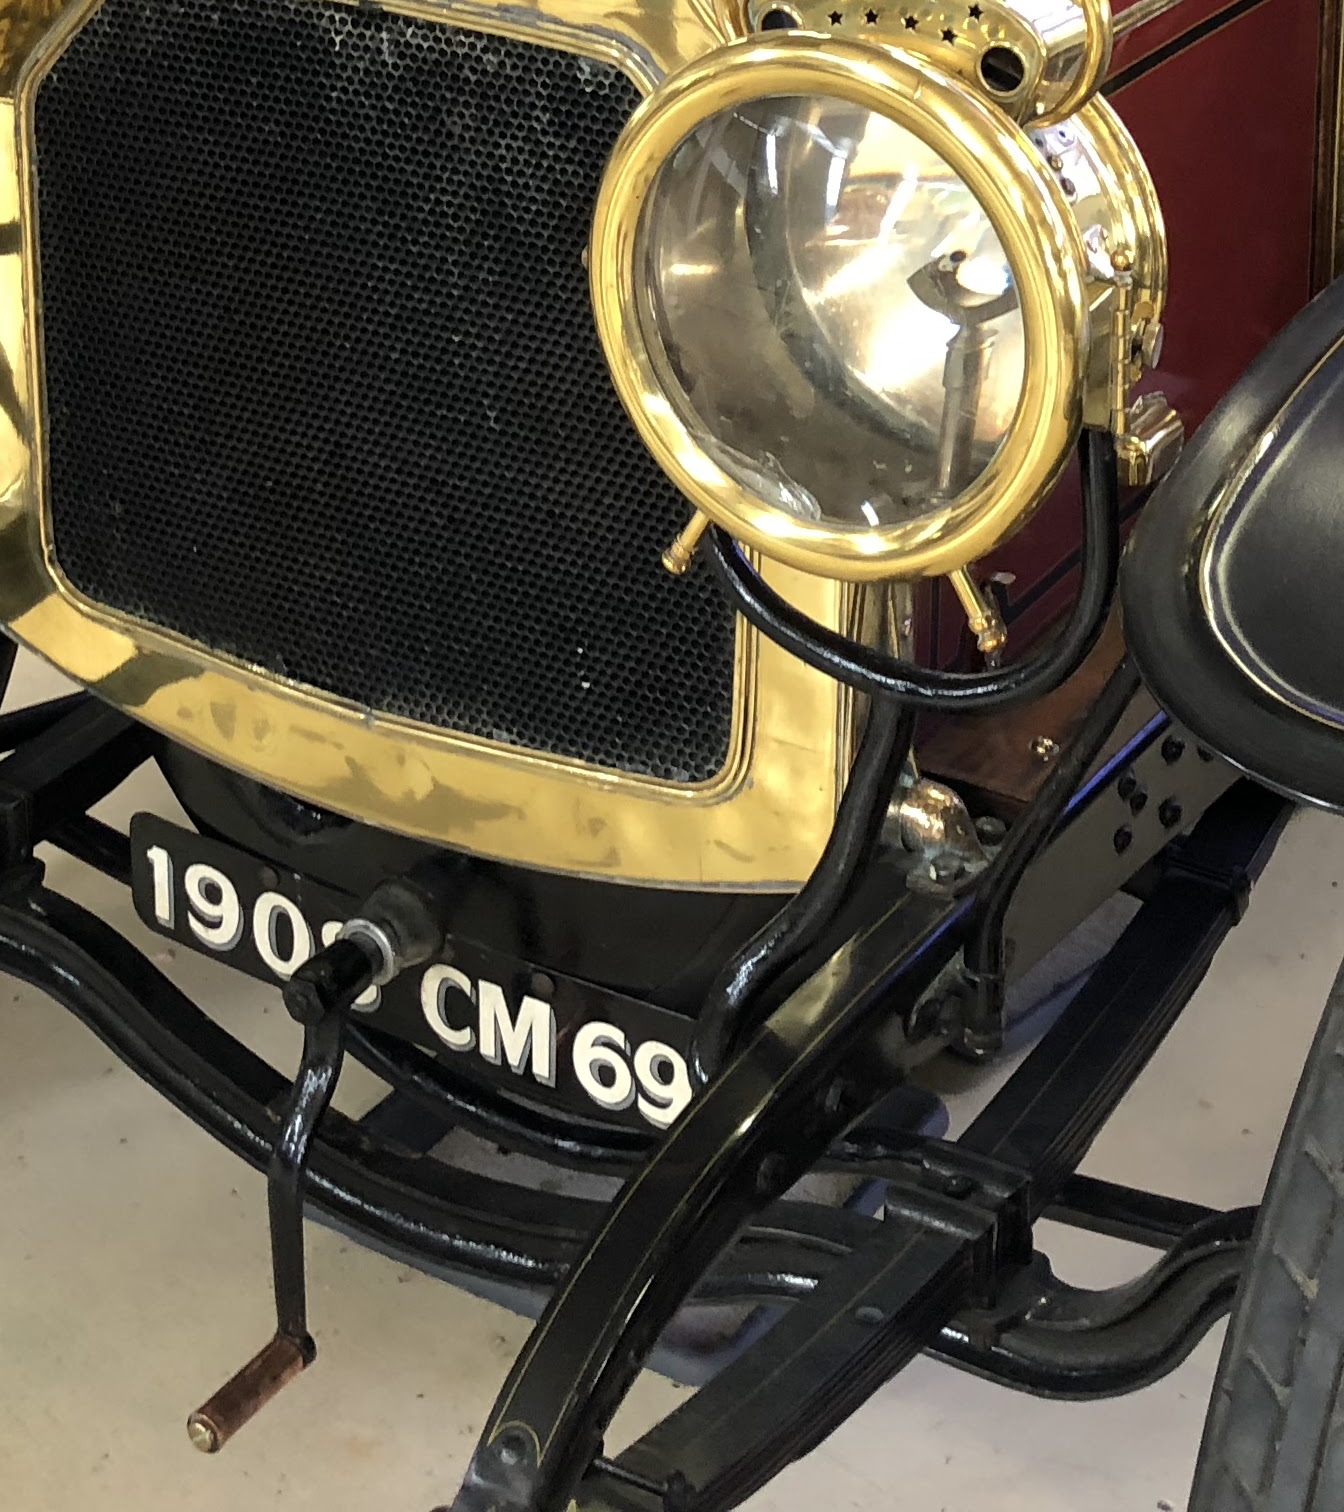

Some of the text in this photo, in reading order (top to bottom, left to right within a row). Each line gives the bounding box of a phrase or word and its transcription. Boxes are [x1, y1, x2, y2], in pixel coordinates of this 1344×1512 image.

[146, 845, 693, 1130] 190 CM 69
